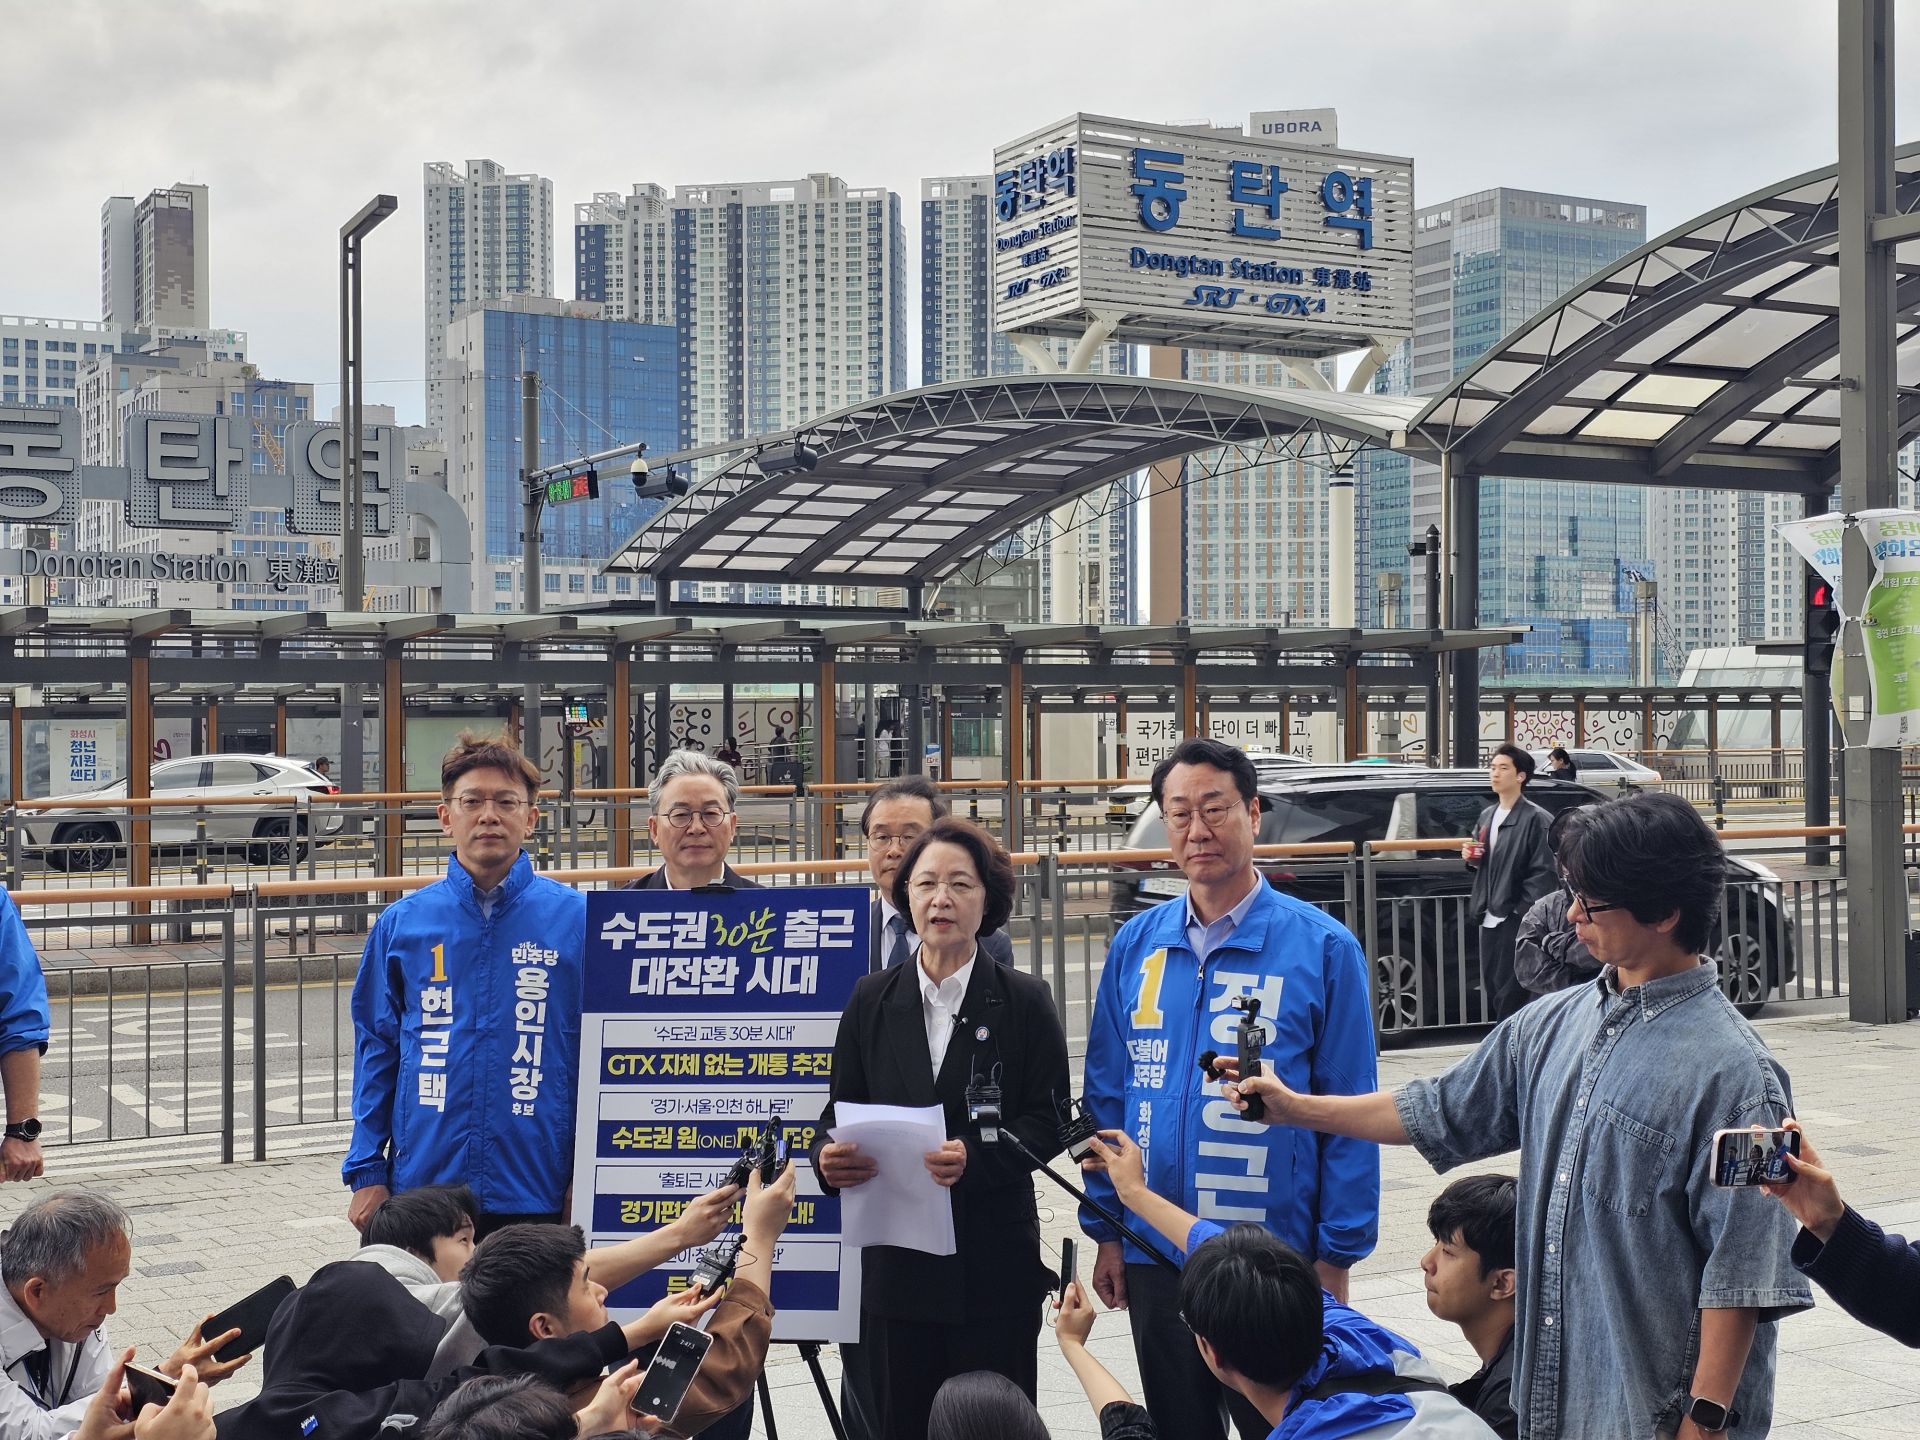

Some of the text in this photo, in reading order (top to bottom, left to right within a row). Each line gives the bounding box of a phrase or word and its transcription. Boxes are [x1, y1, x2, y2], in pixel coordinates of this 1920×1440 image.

[1262, 120, 1322, 135] UBORA
[995, 148, 1075, 222] 동탄역
[1130, 147, 1373, 250] 동탄역
[996, 214, 1074, 251] Dongtan Station
[1131, 247, 1372, 292] Dongtan Station 東灘站
[1184, 285, 1245, 309] SRT
[0, 407, 391, 532] 동탄역
[20, 547, 146, 583] Dongtan
[151, 552, 250, 583] Station
[70, 729, 95, 739] 화성시
[1246, 719, 1258, 739] 더
[70, 740, 96, 753] 청년
[70, 755, 96, 768] 지원
[70, 769, 96, 782] 센터
[601, 906, 855, 954] 수도권 30분 출근
[429, 944, 448, 982] 1
[511, 948, 559, 967] 민주당
[630, 955, 820, 996] 대전환 시대
[1130, 948, 1168, 1030] 1
[509, 967, 549, 1101] 용인시장
[700, 1026, 728, 1042] 교통
[730, 1026, 763, 1042] 30분
[418, 987, 453, 1113] 현근택
[607, 1055, 656, 1076] GTX
[659, 1053, 700, 1075] 지체
[703, 1053, 743, 1075] 없는
[748, 1053, 789, 1075] 개통
[1131, 1065, 1167, 1089] 민주당
[511, 1103, 535, 1117] 후보
[612, 1126, 673, 1150] 수도권
